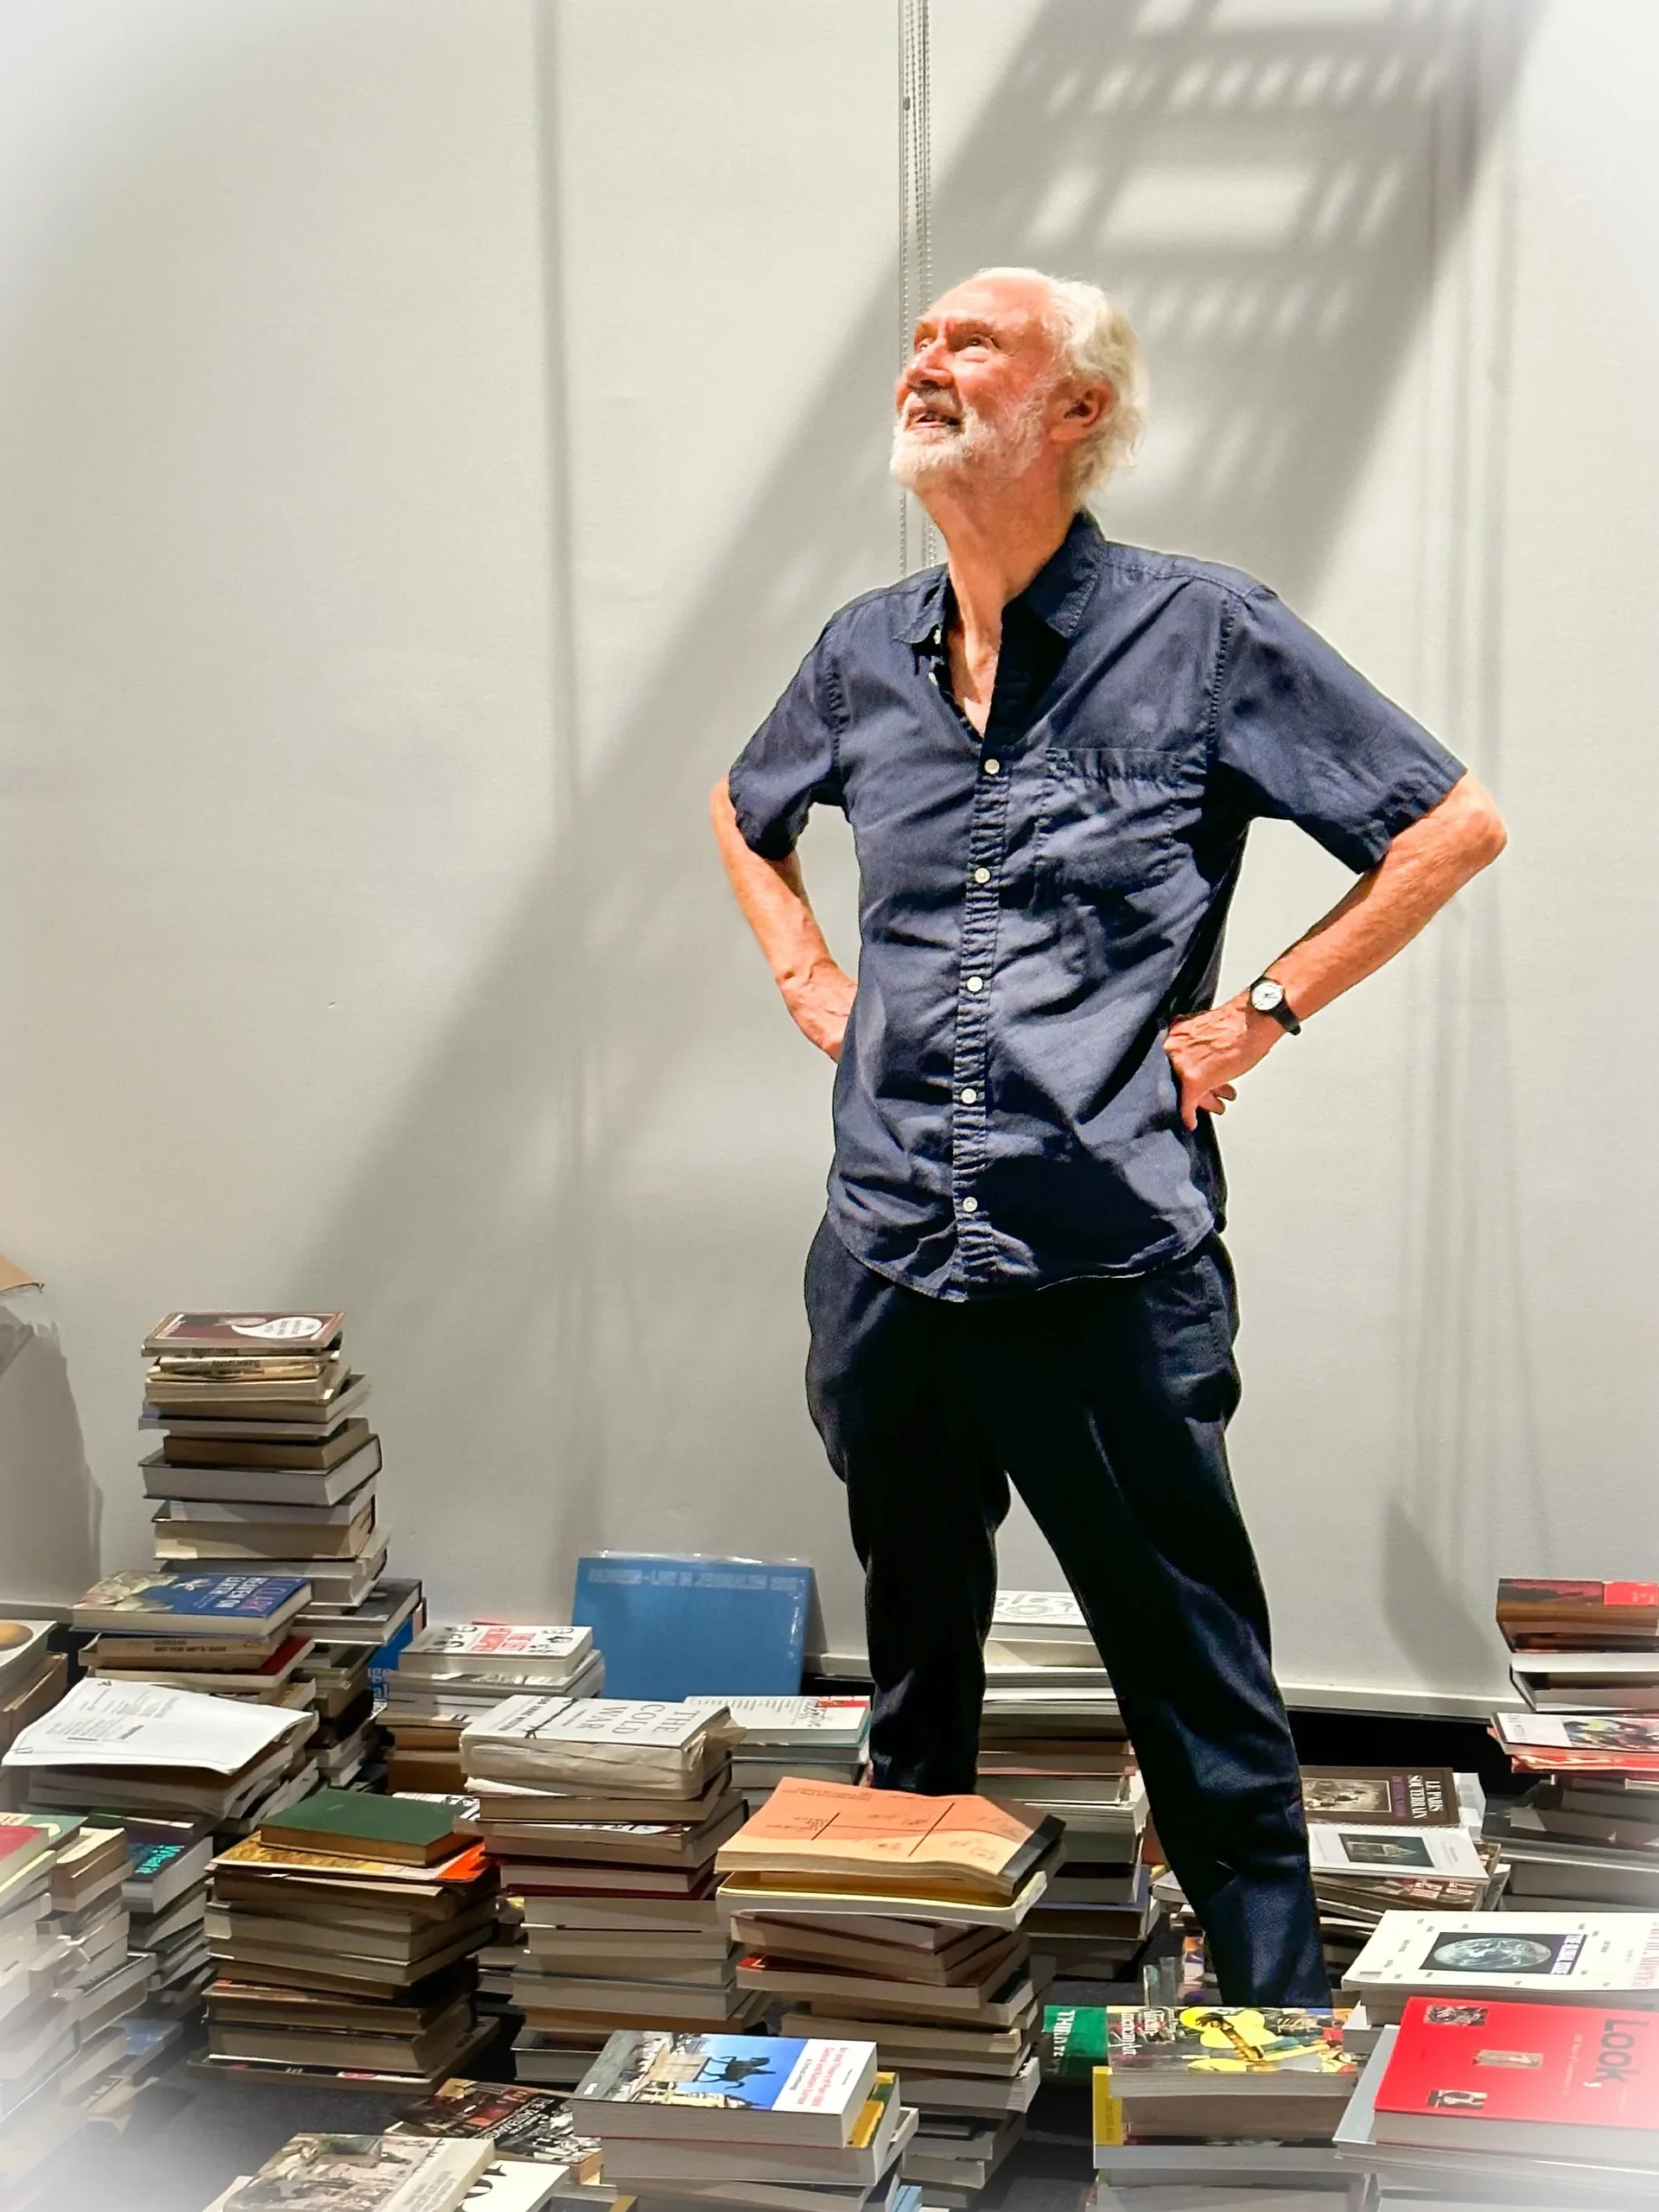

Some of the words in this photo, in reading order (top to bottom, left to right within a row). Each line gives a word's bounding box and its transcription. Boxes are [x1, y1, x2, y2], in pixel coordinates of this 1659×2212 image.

[576, 1706, 629, 1729] WAR
[612, 1704, 665, 1734] COLD
[652, 1711, 700, 1733] THE
[1408, 1775, 1428, 1819] SOUTERRAIN
[1426, 1781, 1441, 1790] LE
[1427, 1791, 1444, 1811] PARIS
[1053, 2009, 1076, 2043] THIRD
